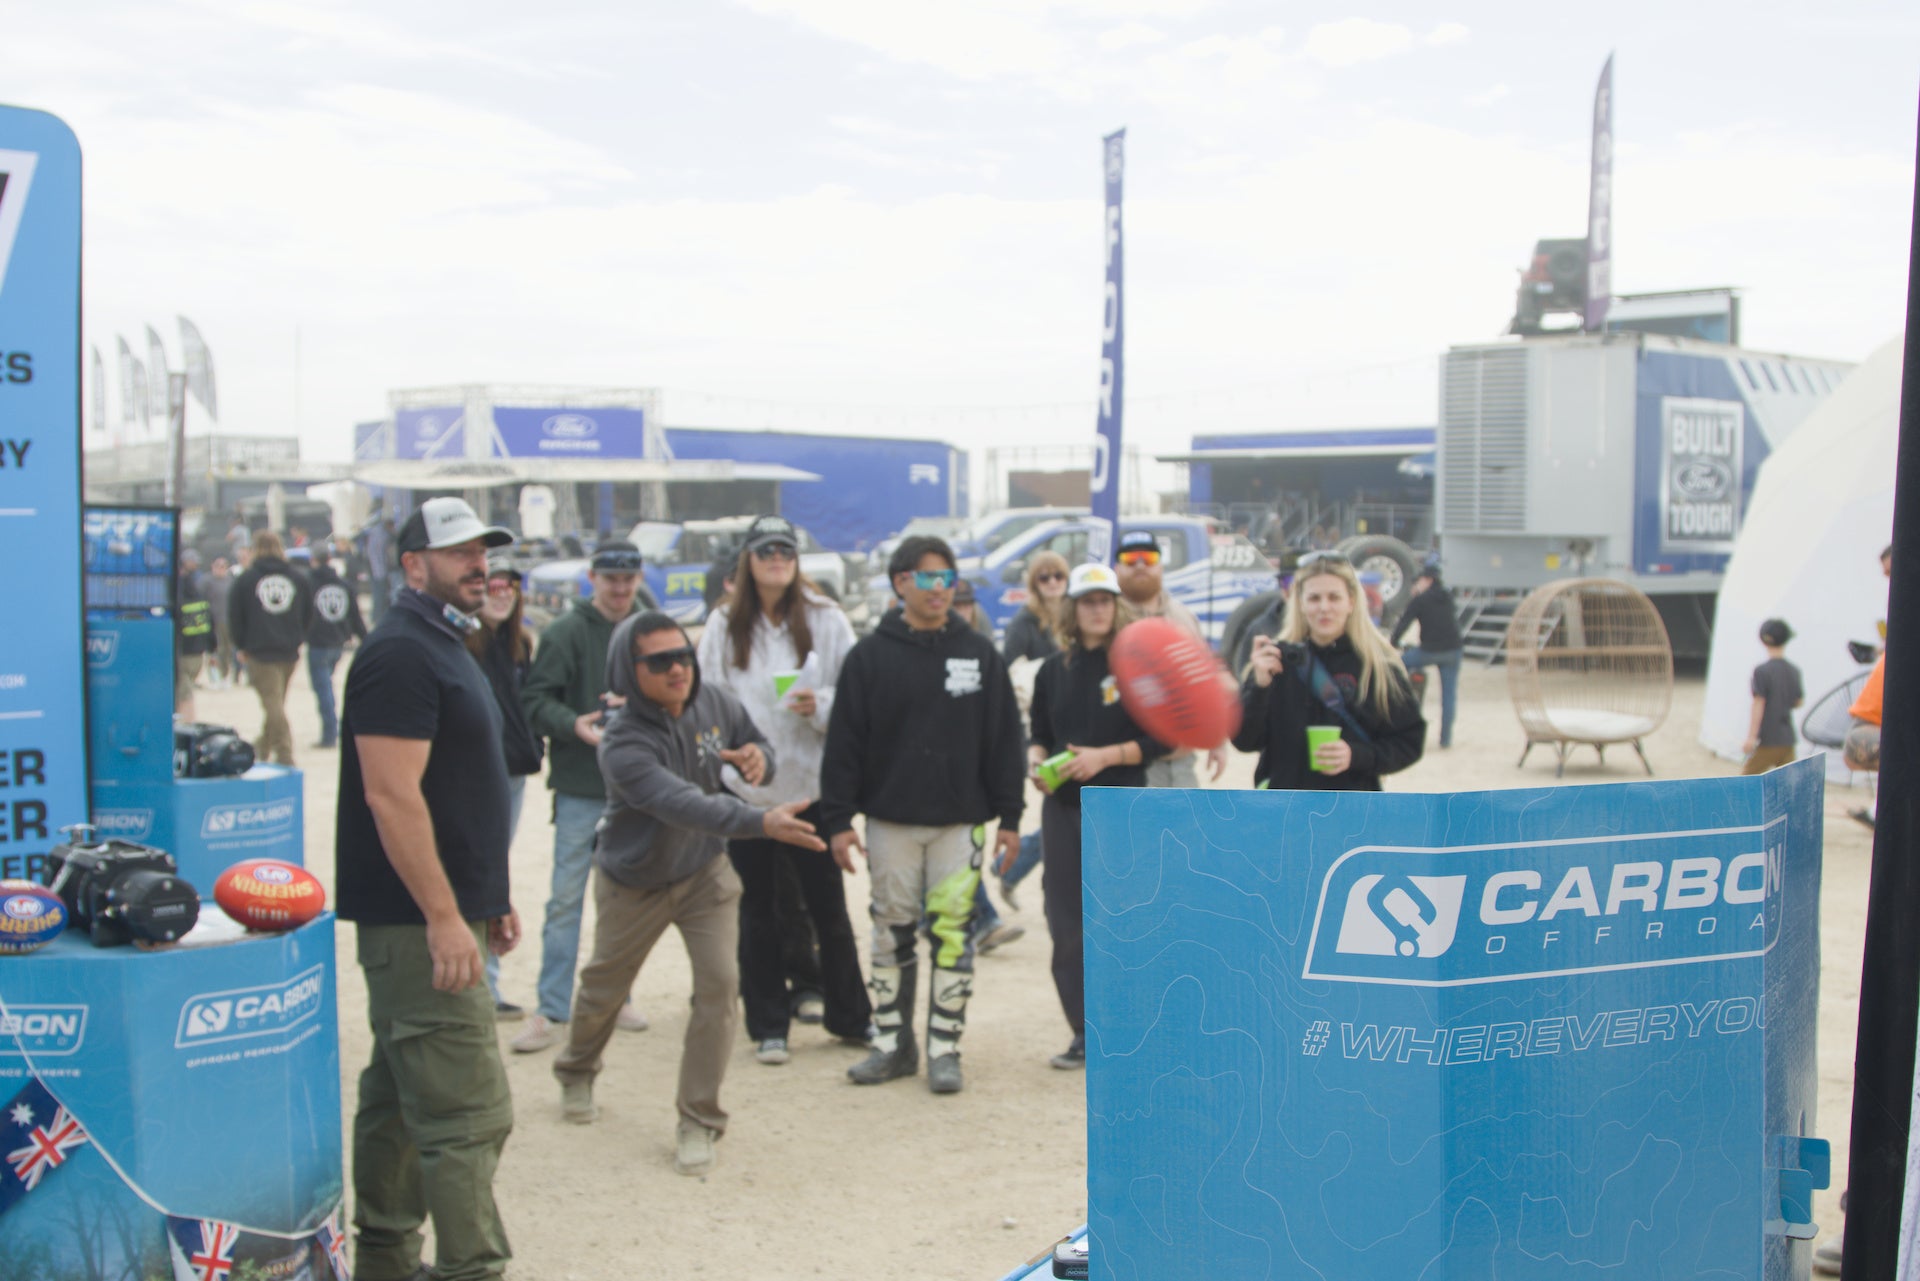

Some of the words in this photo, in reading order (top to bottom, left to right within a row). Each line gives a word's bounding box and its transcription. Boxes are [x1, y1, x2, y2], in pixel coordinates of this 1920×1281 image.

[0, 352, 33, 384] S
[1672, 415, 1733, 455] BUILT
[0, 439, 31, 468] Y
[1670, 502, 1733, 534] TOUGH
[229, 874, 314, 899] SHERRIN
[1479, 842, 1782, 925] CARBON
[1485, 904, 1777, 954] OFFROAD
[235, 974, 319, 1019] CARBON
[26, 1068, 80, 1077] EPERTS
